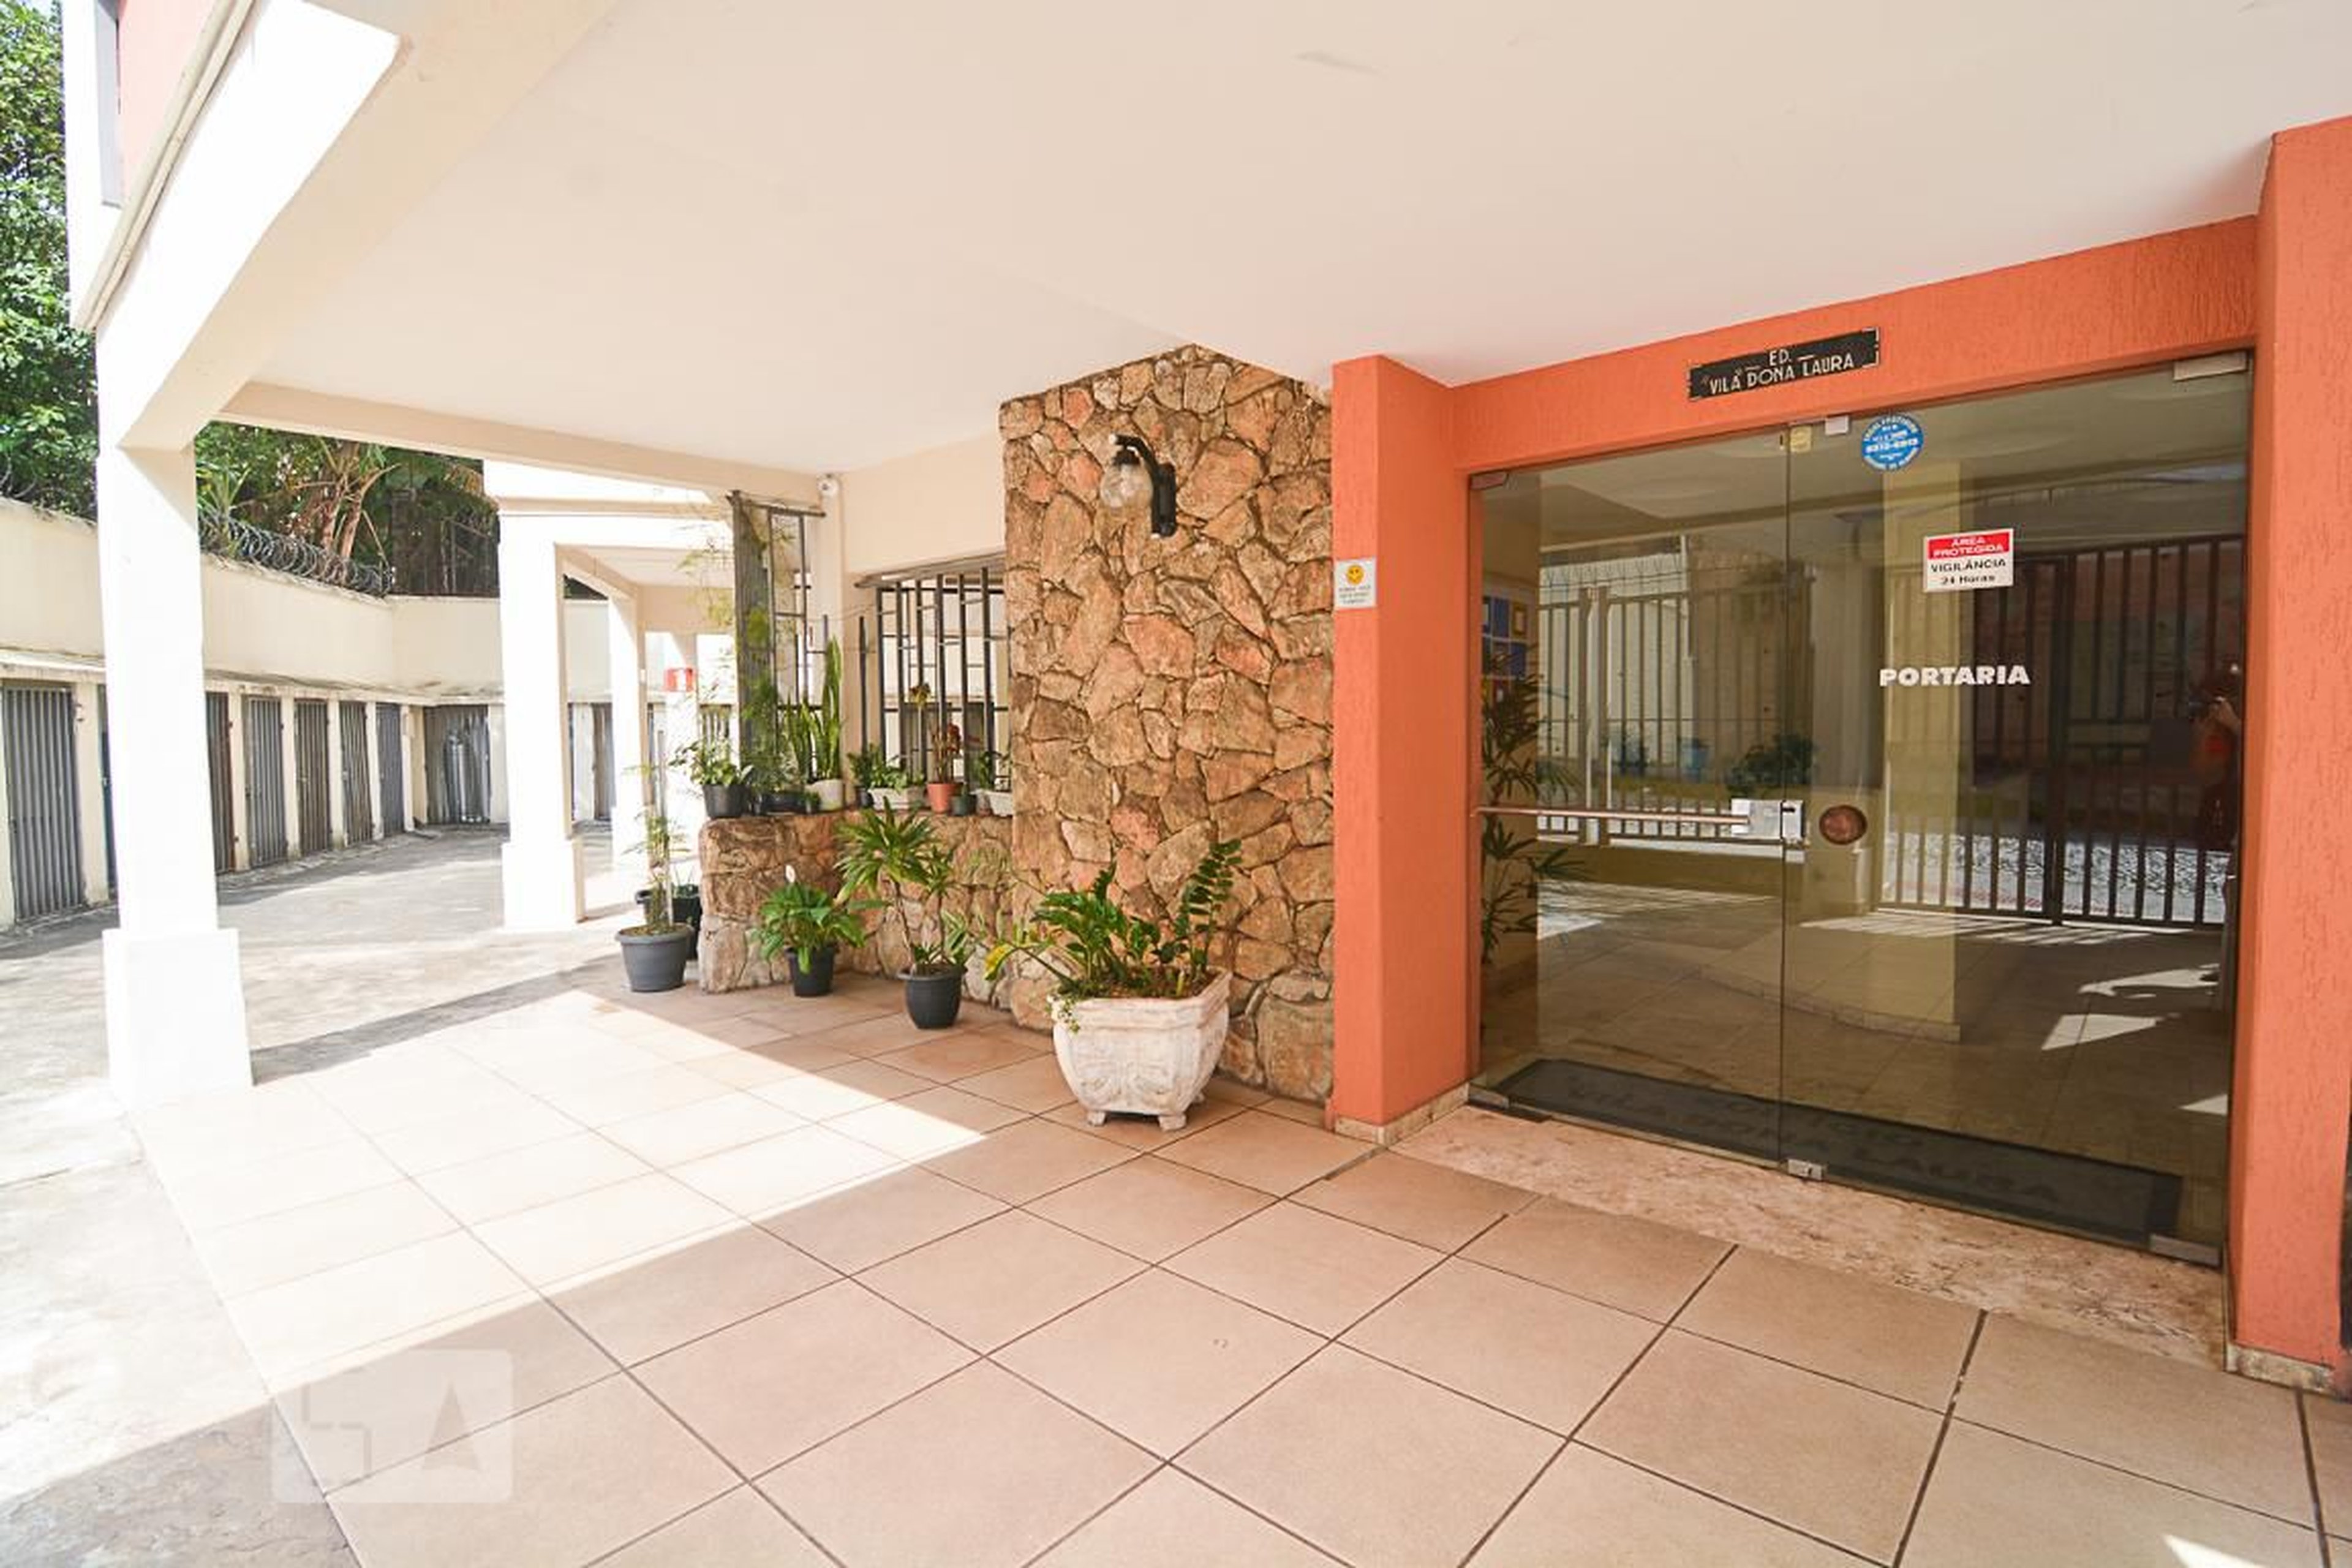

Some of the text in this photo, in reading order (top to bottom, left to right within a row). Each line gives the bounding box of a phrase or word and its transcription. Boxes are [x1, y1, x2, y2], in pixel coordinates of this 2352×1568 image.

[1747, 366, 1795, 388] DONA
[1803, 353, 1855, 377] LAURA
[1932, 545, 2005, 558] PROTEGIDA
[1941, 574, 1996, 586] 24 Horas
[1879, 665, 2031, 687] PORTARIA
